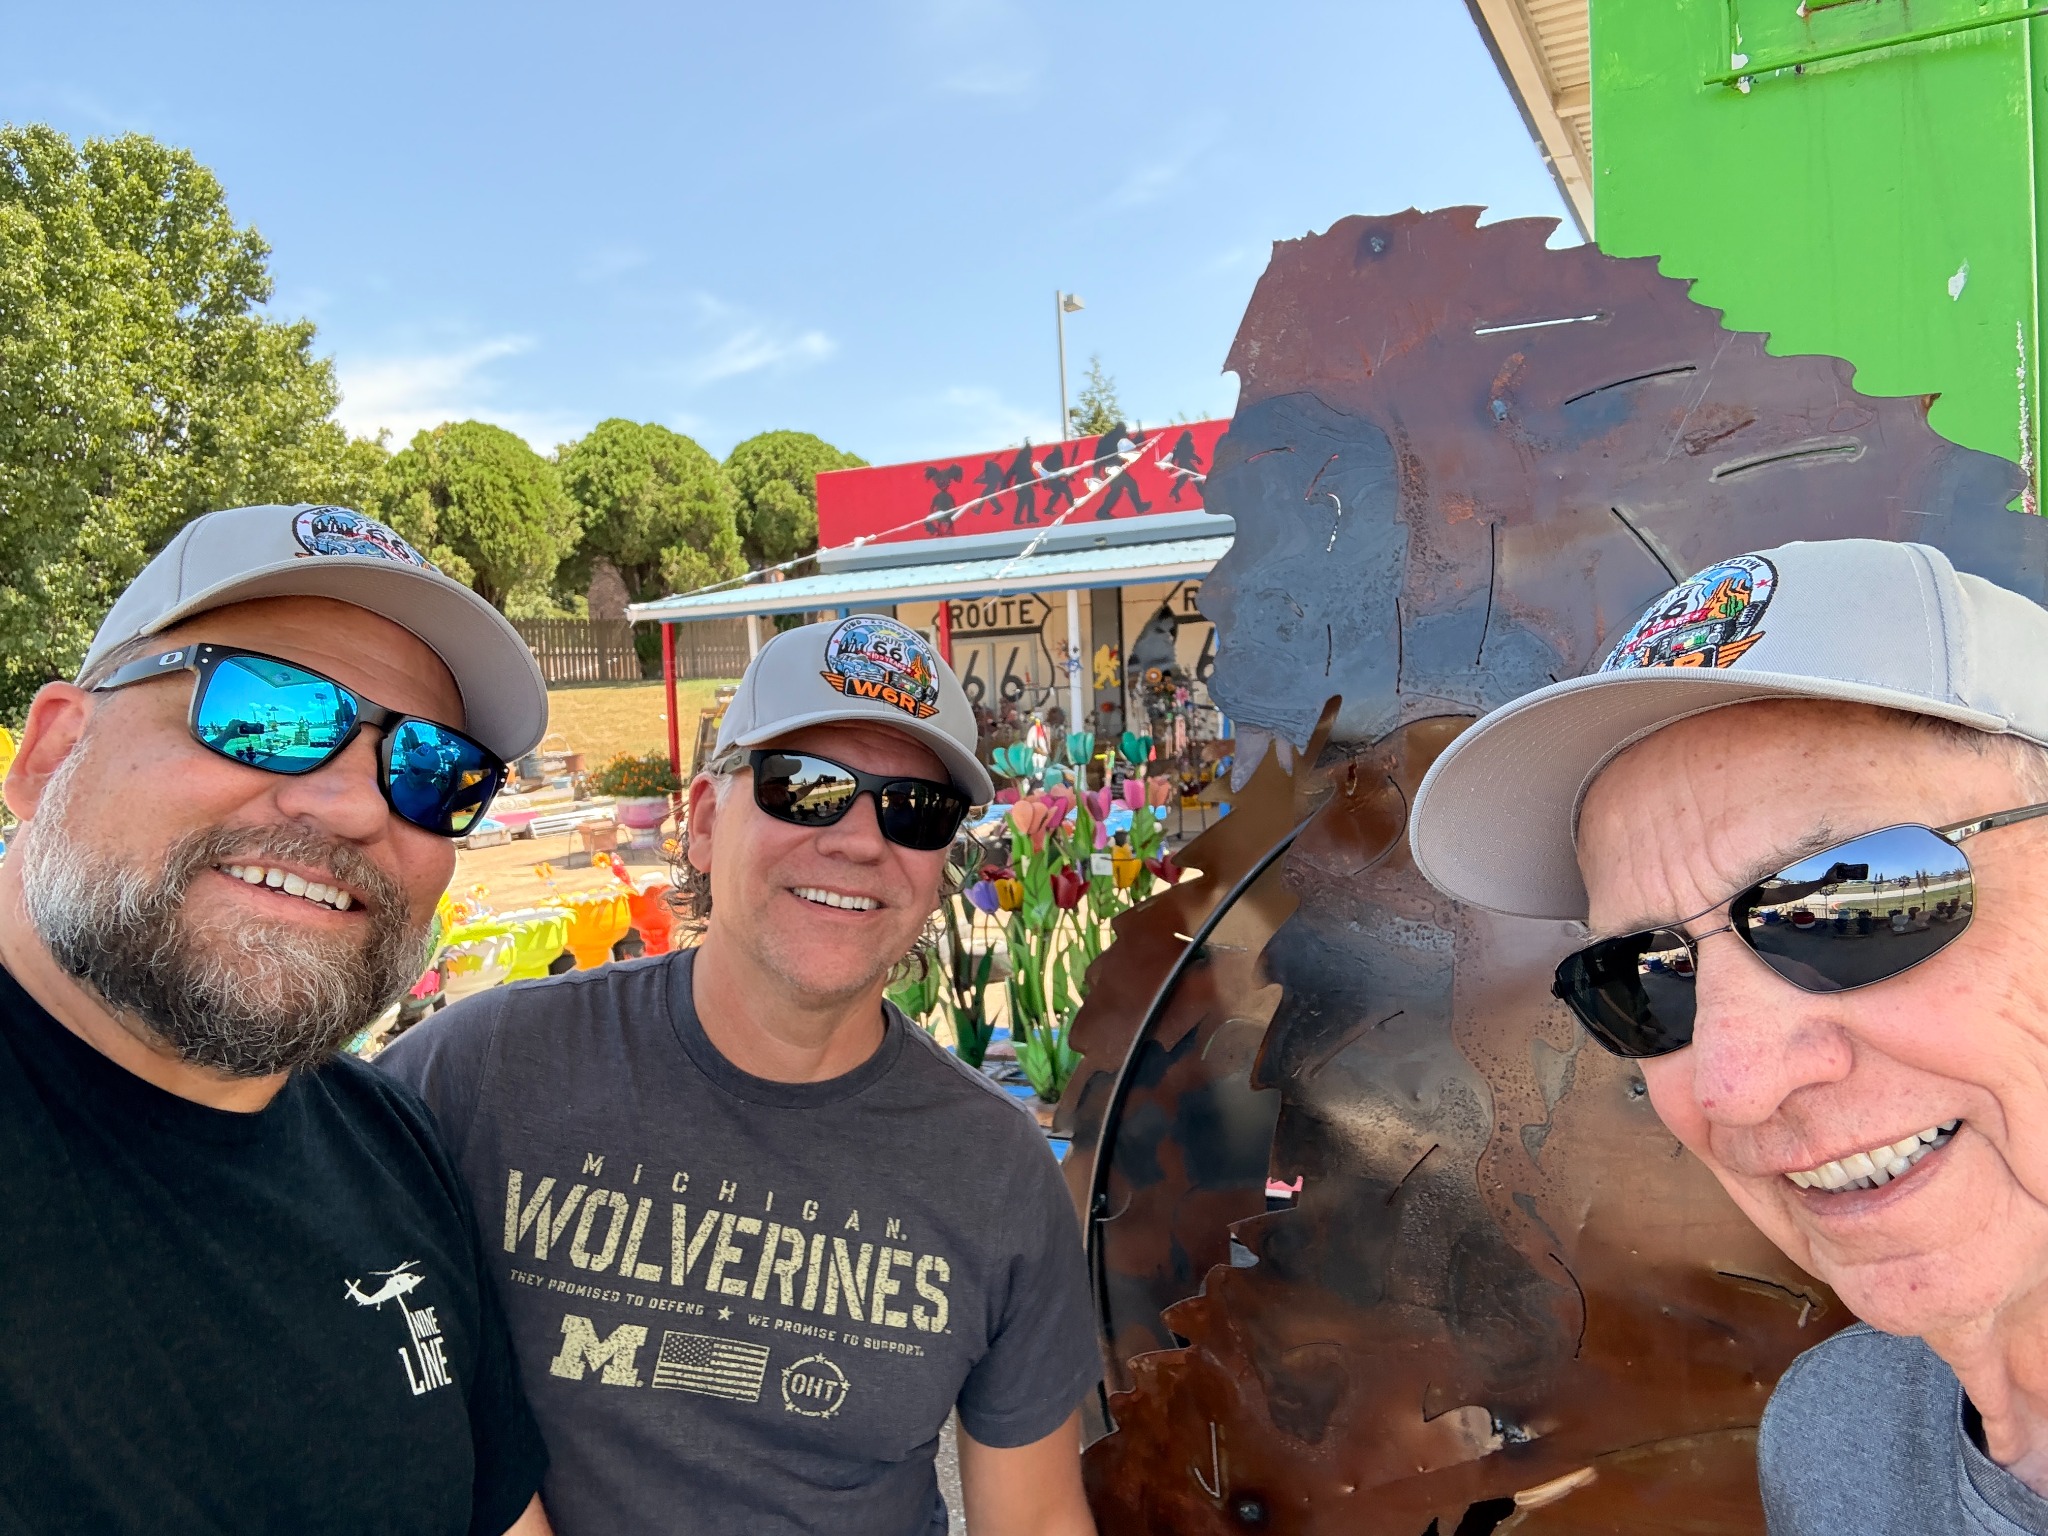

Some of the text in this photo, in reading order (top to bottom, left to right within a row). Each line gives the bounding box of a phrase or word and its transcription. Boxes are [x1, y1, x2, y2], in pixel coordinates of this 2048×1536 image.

[950, 599, 1035, 629] ROUTE
[873, 634, 903, 648] ROUTE
[873, 640, 903, 662] 66
[962, 646, 1025, 704] 66
[852, 678, 917, 714] W6R
[503, 1167, 951, 1334] WOLVERINES
[408, 1306, 442, 1339] NINE
[510, 1269, 544, 1287] THEY
[548, 1279, 621, 1303] PROMISED
[626, 1293, 645, 1306] TO
[648, 1298, 705, 1316] DEFEND
[747, 1313, 771, 1328] WE
[774, 1319, 838, 1342] PROMISE
[842, 1333, 859, 1346] TO
[398, 1336, 452, 1396] LINE
[790, 1373, 839, 1402] OHT
